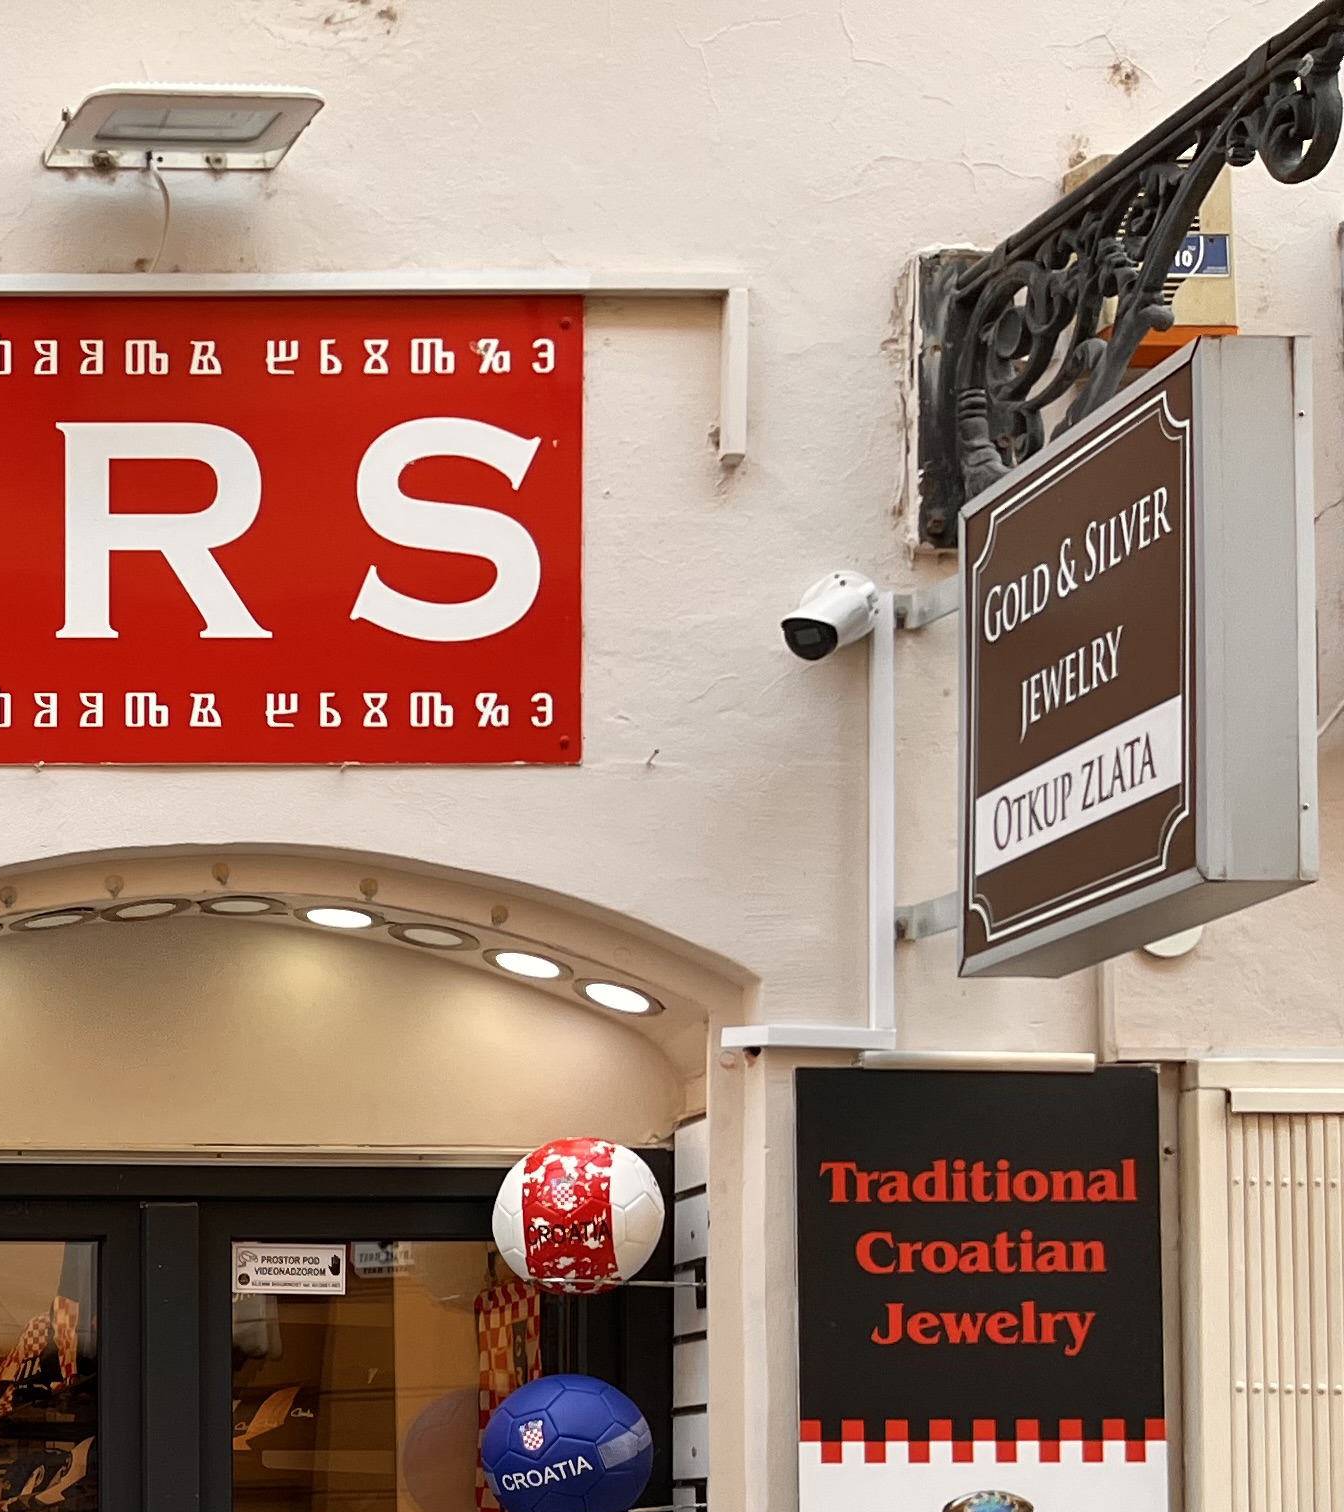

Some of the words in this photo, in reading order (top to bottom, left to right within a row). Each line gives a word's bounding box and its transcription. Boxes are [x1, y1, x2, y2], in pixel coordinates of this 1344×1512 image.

[1055, 537, 1080, 595] &
[1019, 624, 1125, 744] JEWELRY
[1080, 731, 1158, 811] ZLATA
[819, 1159, 1137, 1203] Traditional
[526, 1219, 611, 1247] CROATIA
[855, 1229, 1108, 1274] Croatian
[254, 1267, 326, 1276] VIDEONADZOROM
[260, 1255, 300, 1265] PROSTOR
[303, 1256, 320, 1265] POD
[870, 1300, 1095, 1356] Jewelry
[501, 1454, 594, 1491] CROATIA
